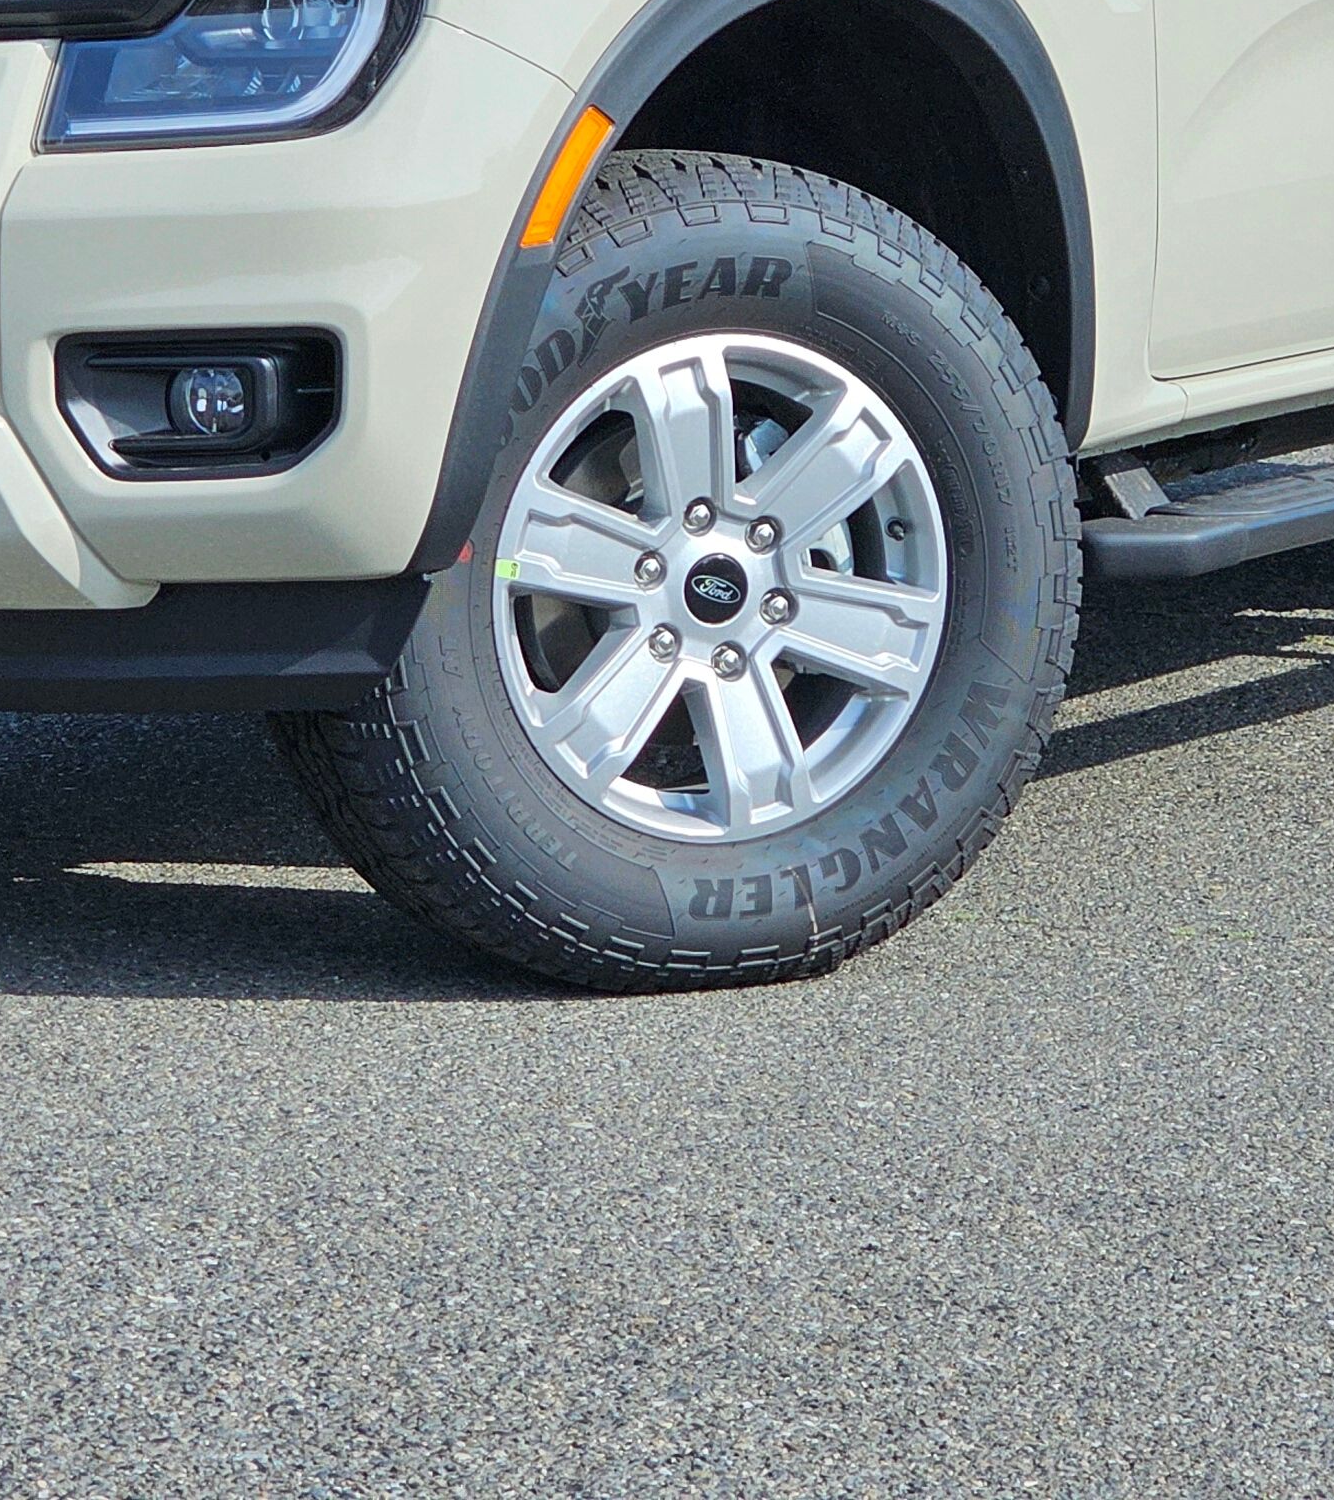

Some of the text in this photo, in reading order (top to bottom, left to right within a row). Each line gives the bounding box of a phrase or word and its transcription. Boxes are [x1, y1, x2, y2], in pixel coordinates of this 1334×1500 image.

[500, 255, 793, 448] ODYEAR
[699, 578, 734, 601] Ford
[452, 706, 578, 872] TERRITORY
[688, 680, 1012, 922] WRANGLER
